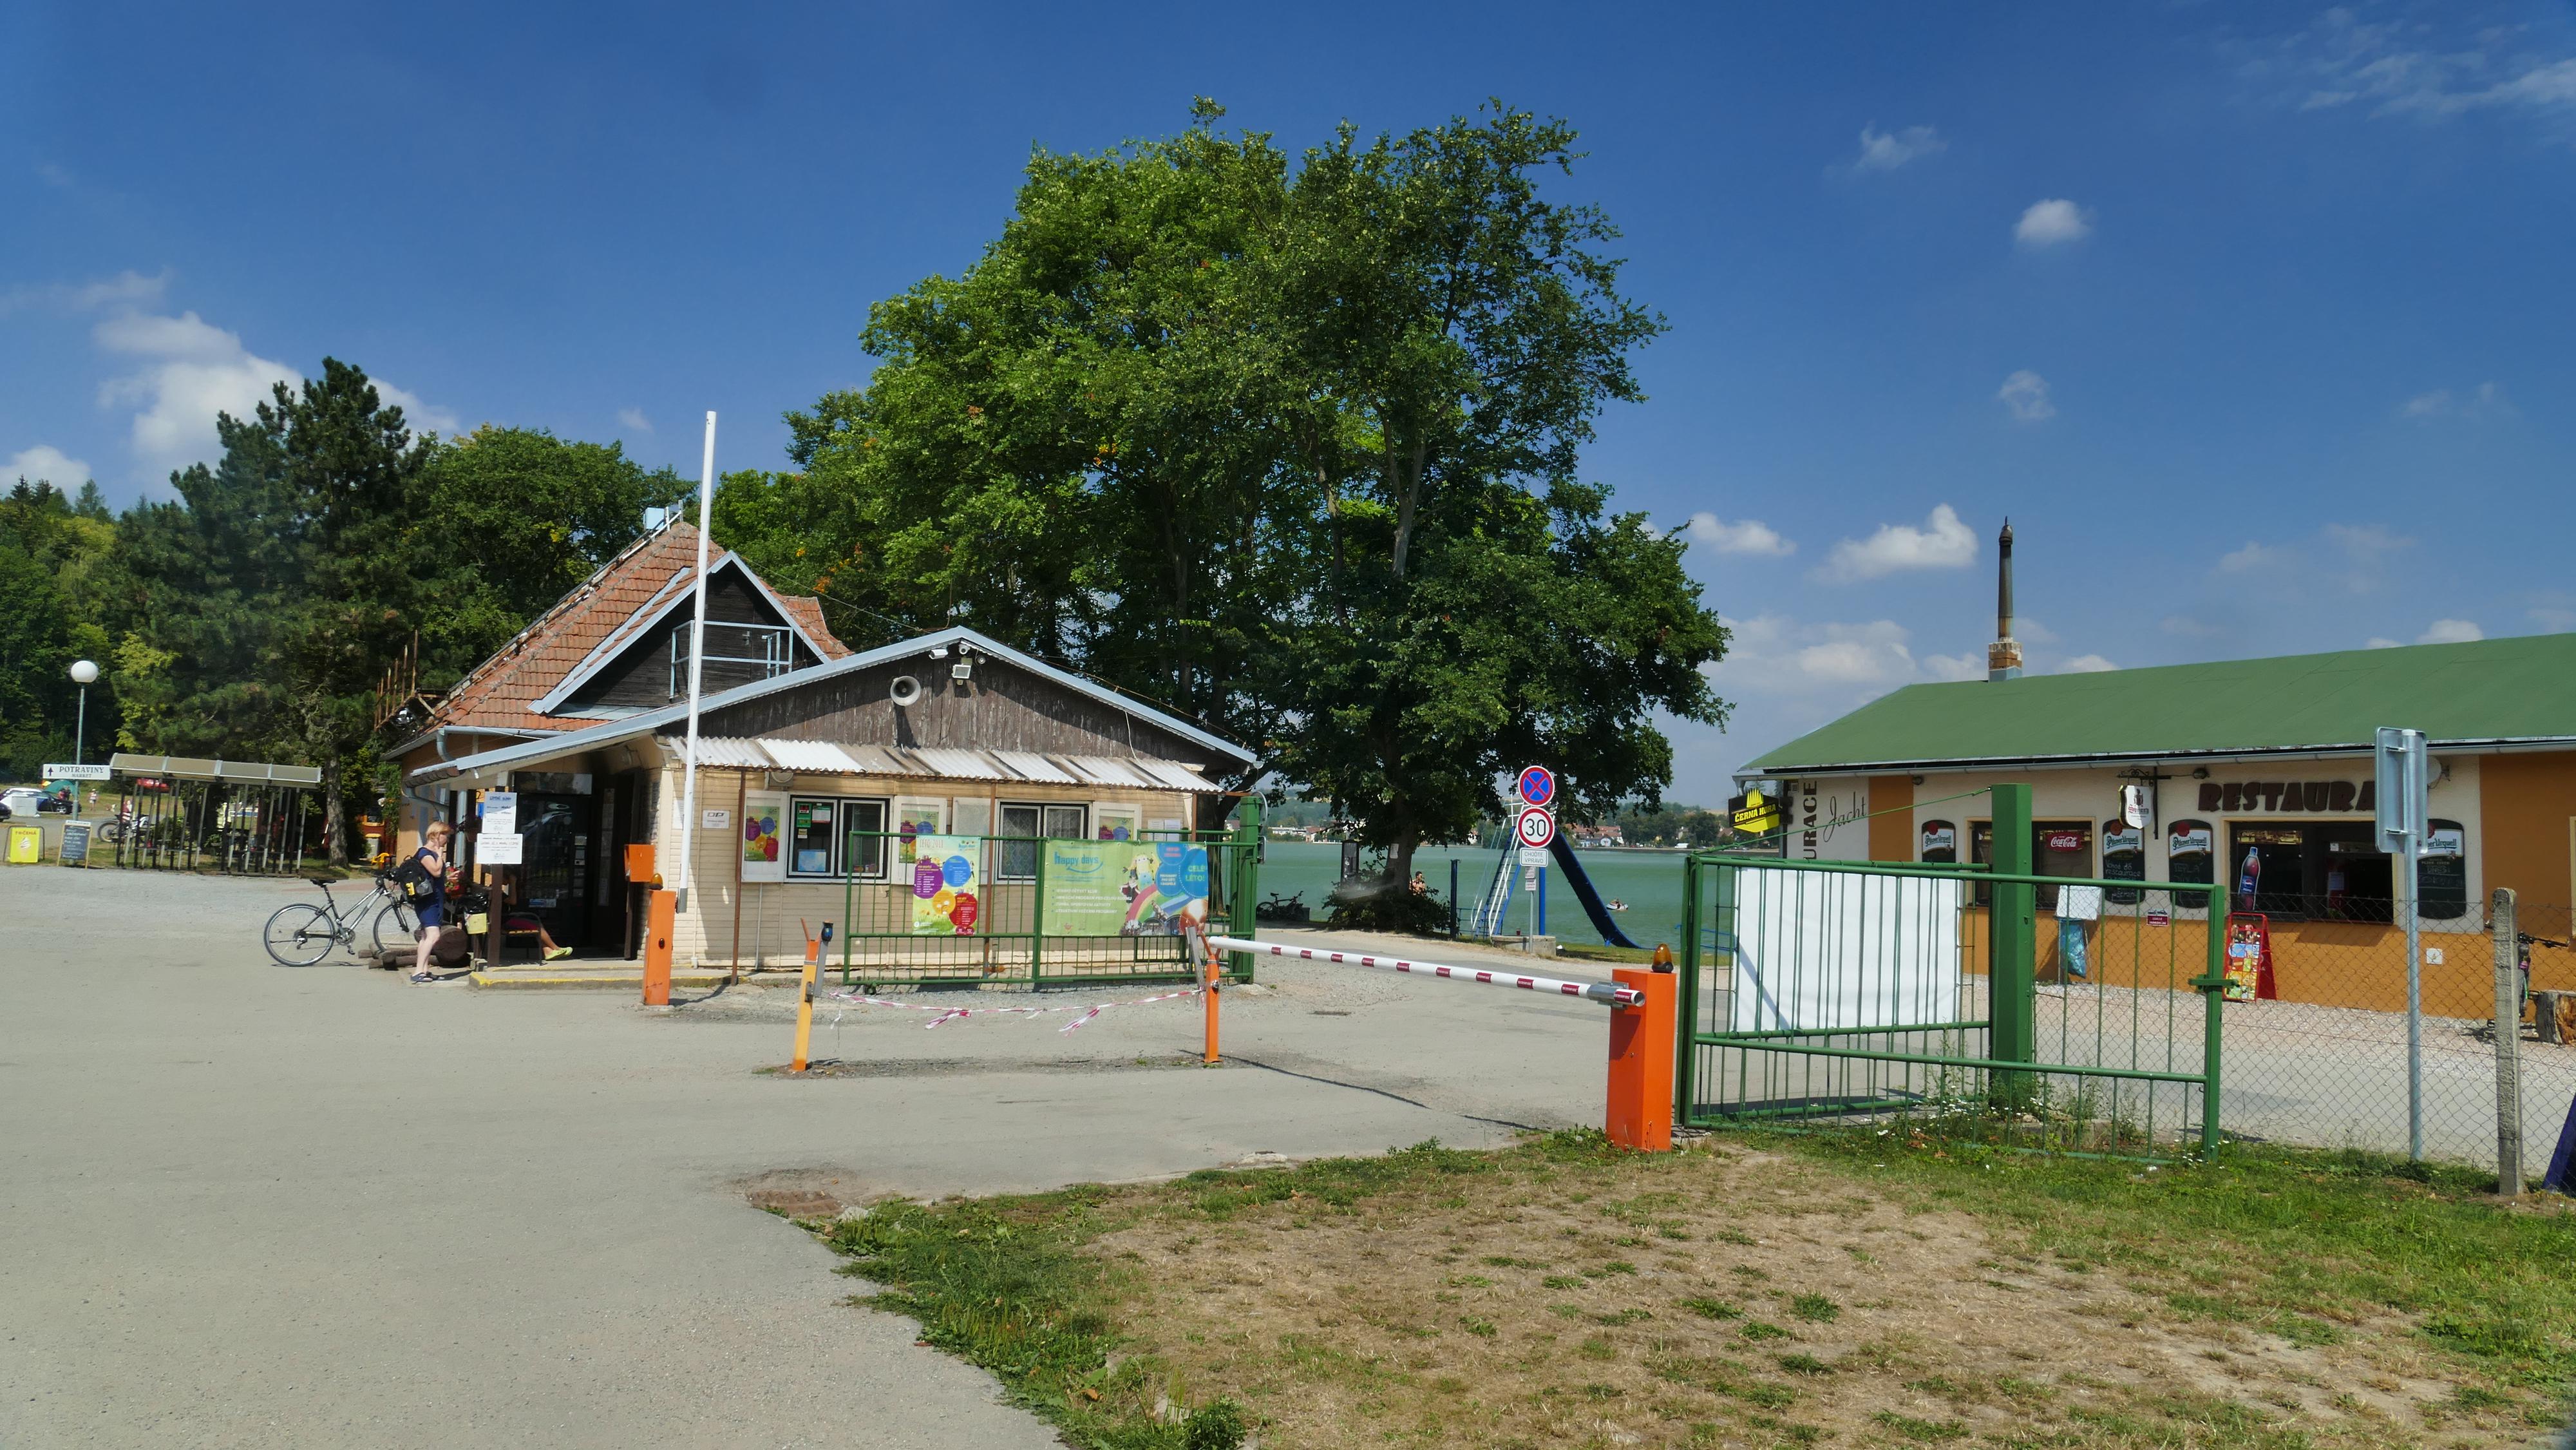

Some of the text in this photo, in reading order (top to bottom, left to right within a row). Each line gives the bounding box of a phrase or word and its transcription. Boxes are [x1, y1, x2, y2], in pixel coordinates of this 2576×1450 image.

[1734, 803, 1776, 823] ČERNÁ HORA
[1526, 818, 1546, 837] 30
[2050, 836, 2077, 848] Coca-Cola
[1054, 851, 1099, 866] happy days
